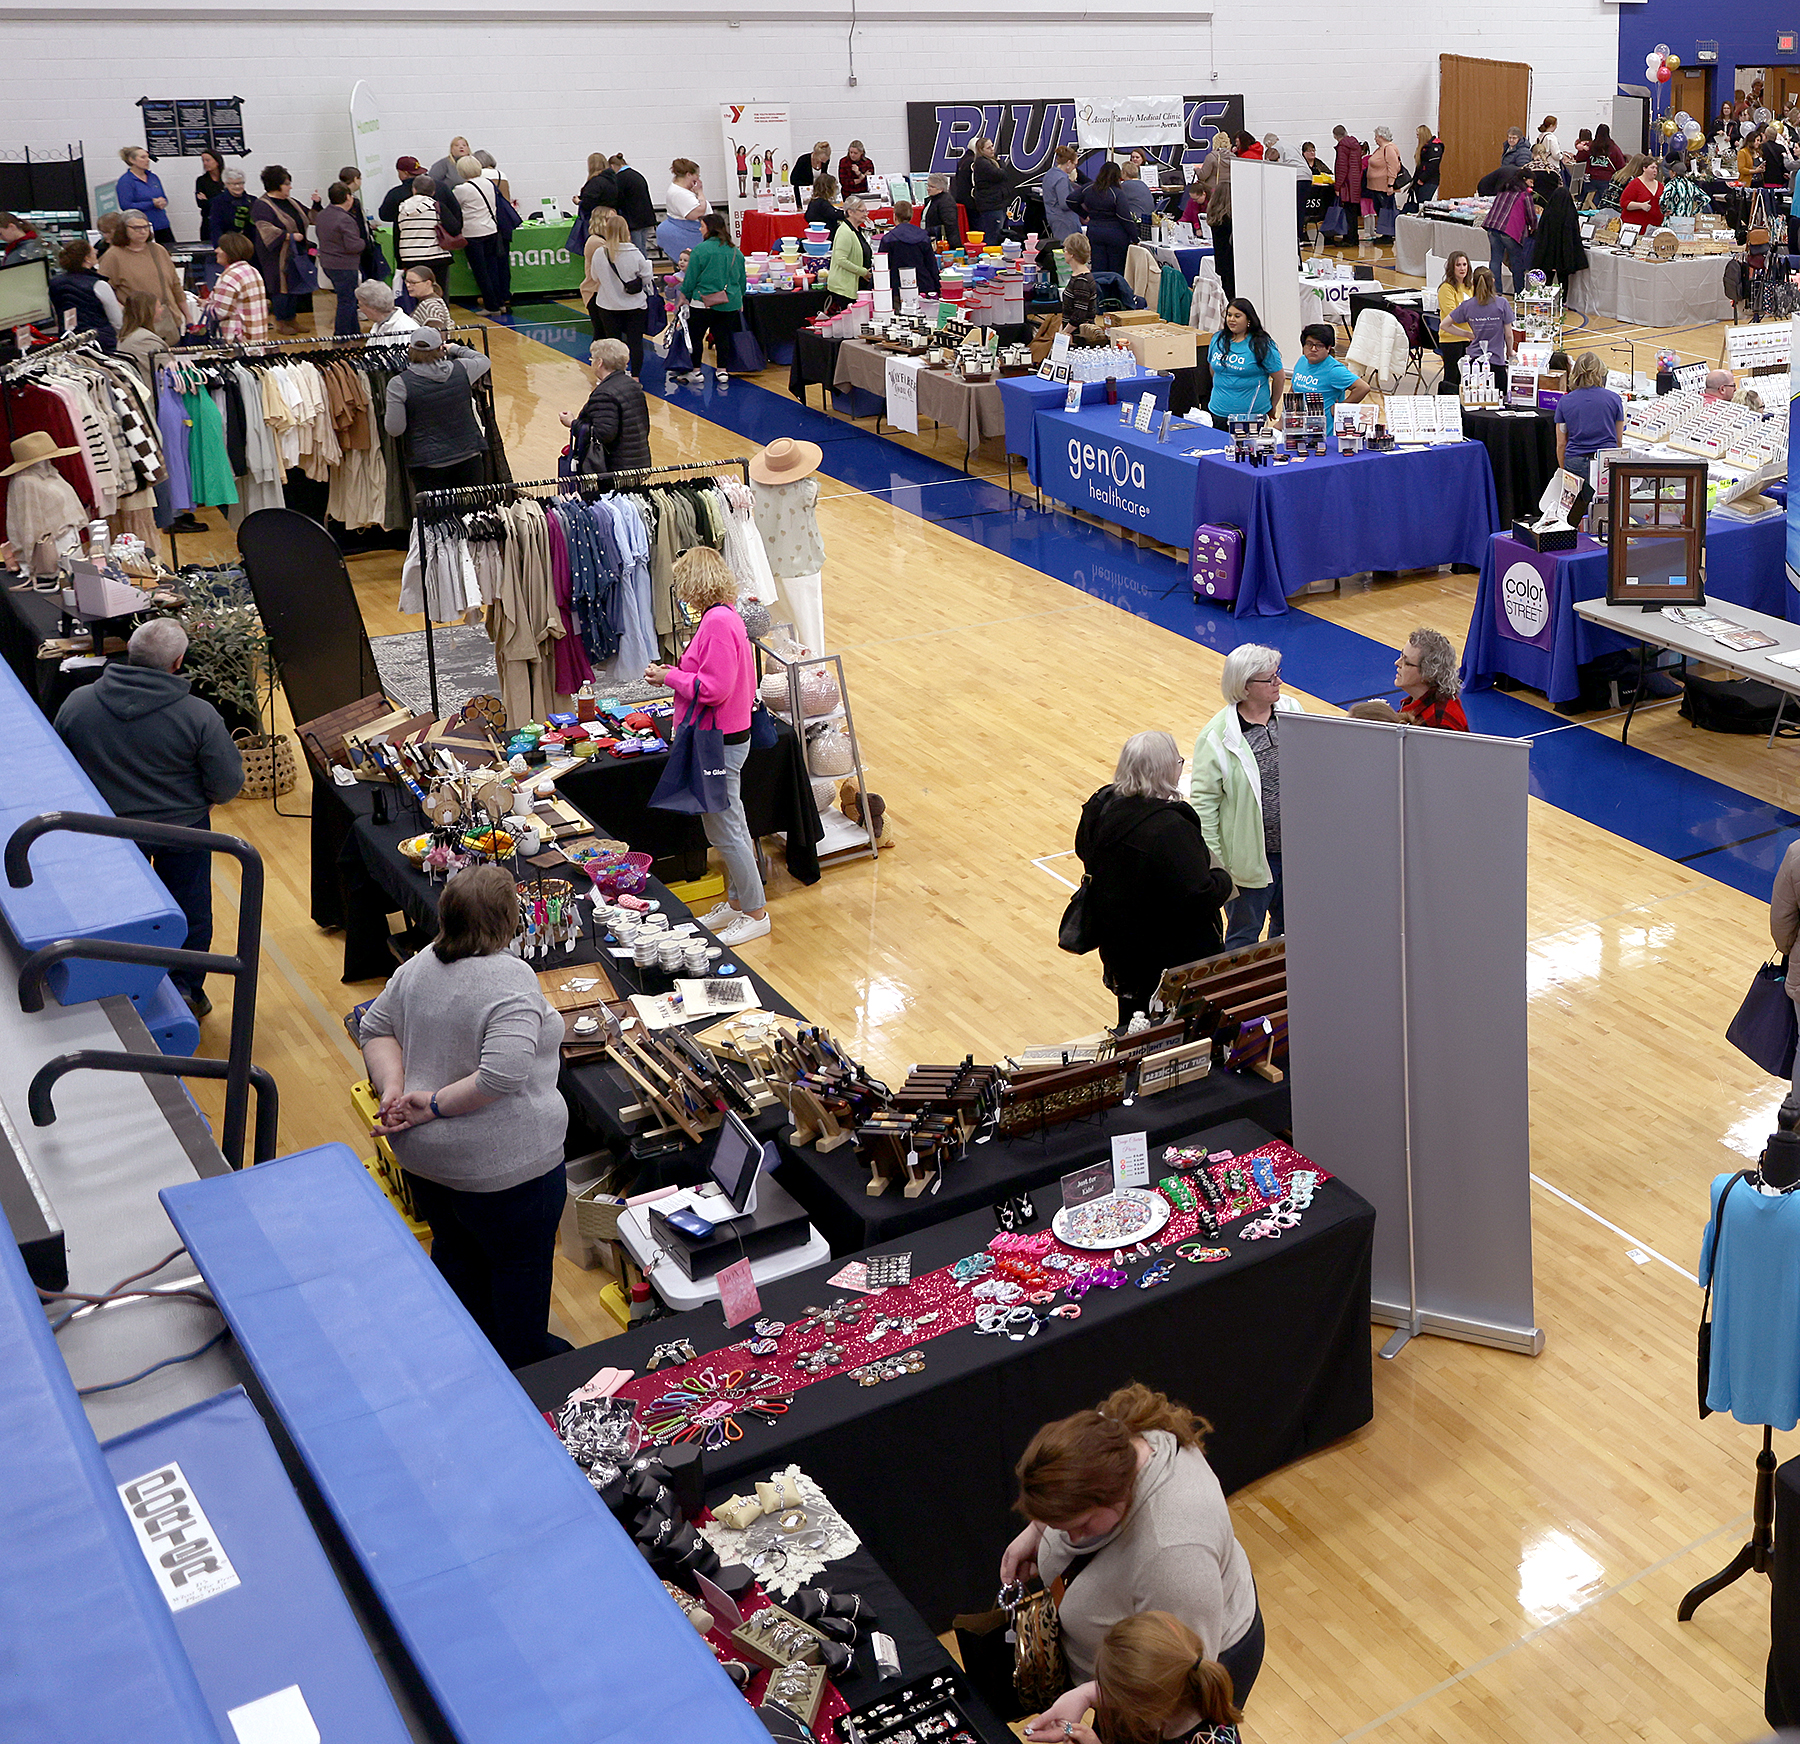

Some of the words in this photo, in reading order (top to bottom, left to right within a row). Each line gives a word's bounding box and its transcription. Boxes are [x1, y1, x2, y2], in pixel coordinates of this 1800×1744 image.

[1113, 114, 1134, 124] Family
[1135, 113, 1161, 122] Medical
[1162, 112, 1181, 120] Clinic
[1068, 438, 1146, 489] genOa
[1505, 577, 1544, 602] color
[1505, 600, 1543, 624] STREET
[1076, 1179, 1088, 1188] Just
[1088, 1176, 1097, 1184] for
